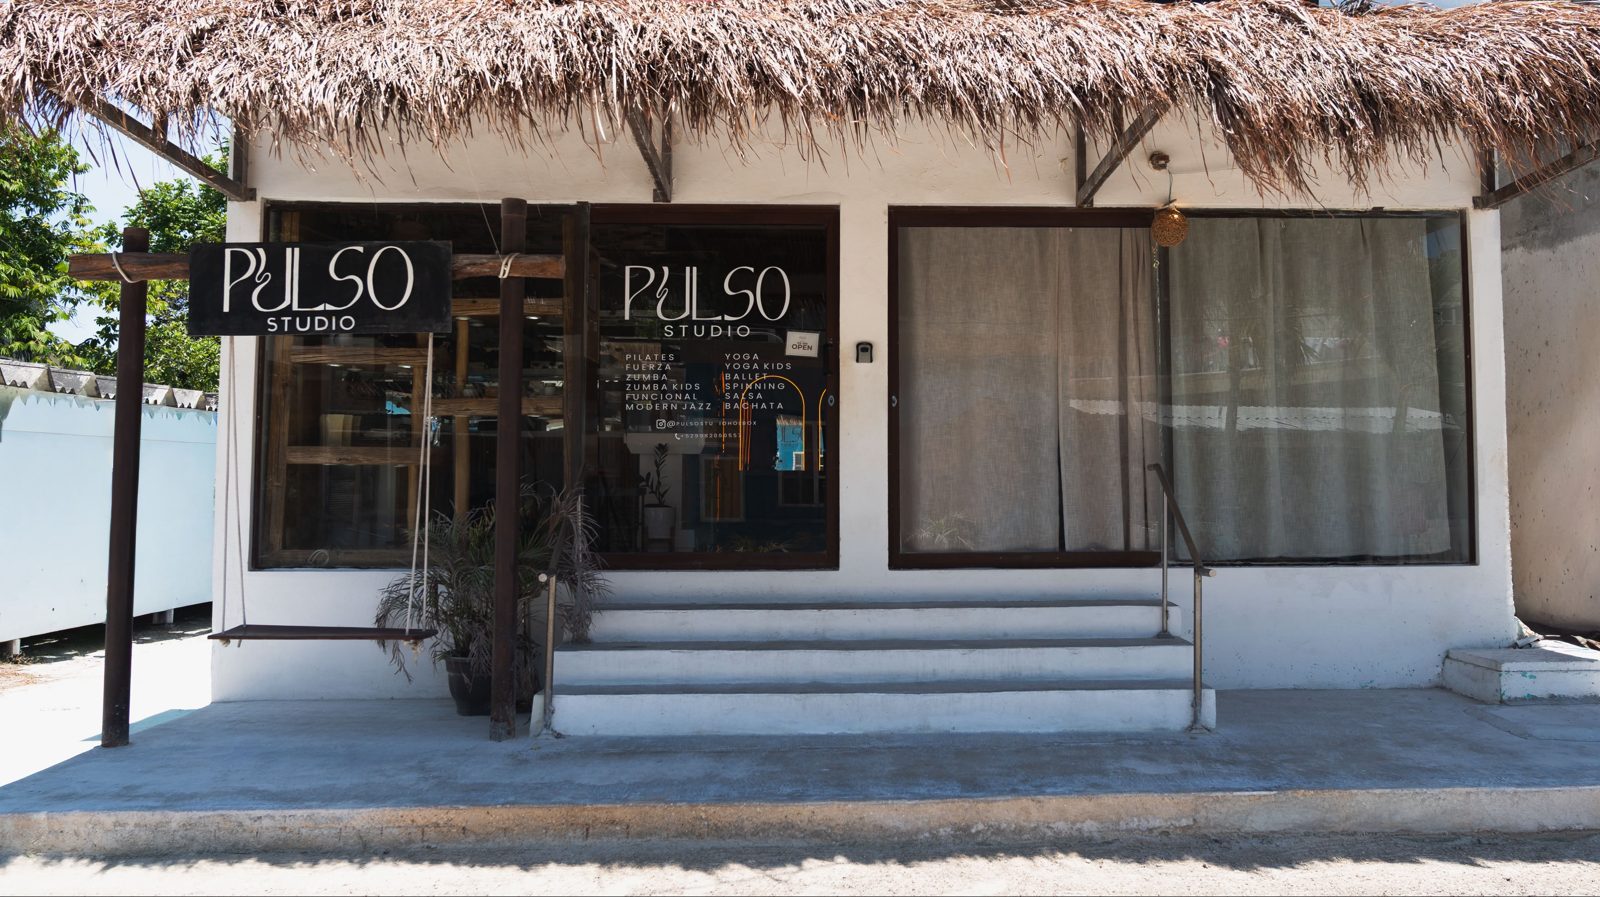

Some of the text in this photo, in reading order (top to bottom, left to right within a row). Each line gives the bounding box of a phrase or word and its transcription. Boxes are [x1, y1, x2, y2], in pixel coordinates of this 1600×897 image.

[222, 245, 415, 313] PULSO
[624, 265, 791, 322] PULSO
[266, 315, 356, 332] STUDIO
[663, 324, 751, 338] STUDIO
[791, 343, 813, 351] OPEN
[625, 353, 675, 361] PILATES
[724, 353, 760, 361] YOGA
[625, 363, 672, 371] FUERZA
[724, 362, 793, 370] YOGA KIDS
[625, 373, 668, 381] ZUMBA
[724, 372, 769, 380] BALLET
[625, 383, 701, 391] ZUMBA KIDS
[724, 382, 786, 390] SPINNING
[625, 393, 698, 401] FUNCIONAL
[724, 392, 764, 400] SALSA
[625, 402, 713, 411] MODERN JAZZ
[724, 401, 785, 410] BACHATA
